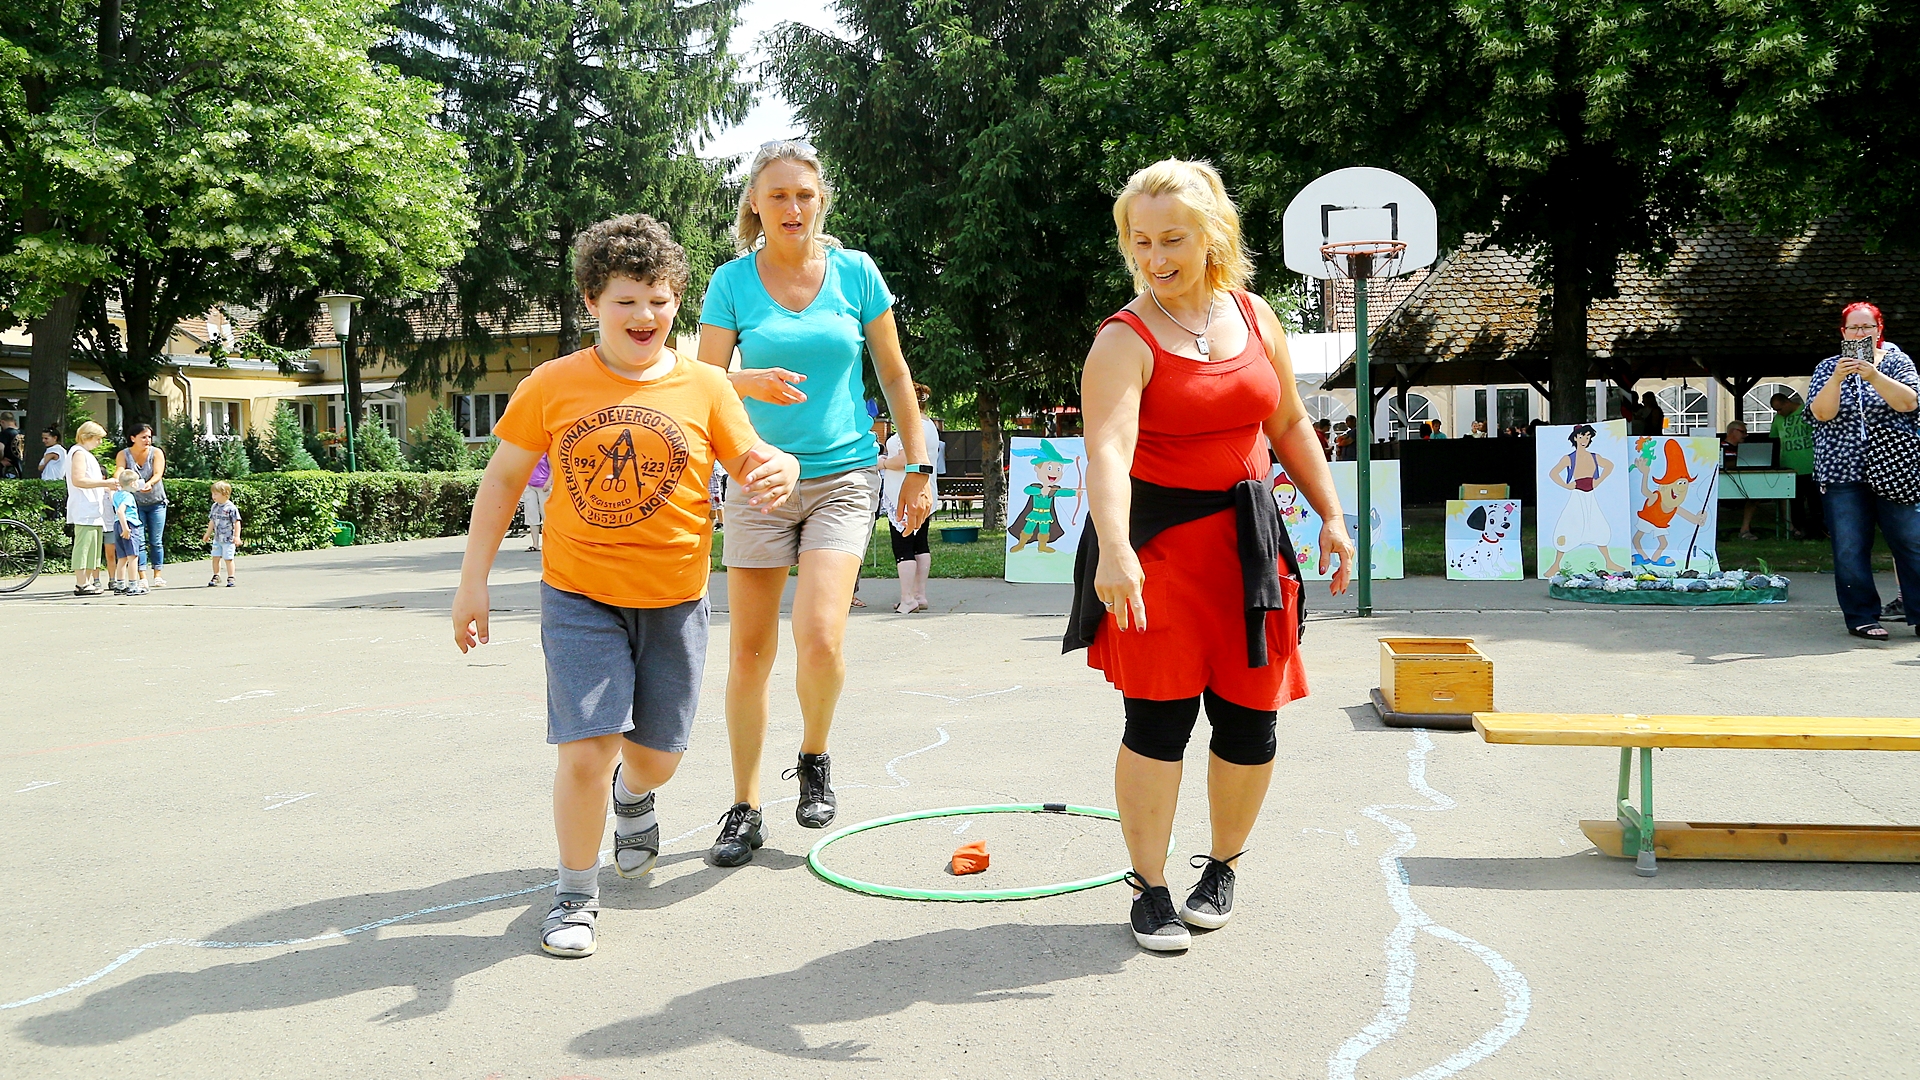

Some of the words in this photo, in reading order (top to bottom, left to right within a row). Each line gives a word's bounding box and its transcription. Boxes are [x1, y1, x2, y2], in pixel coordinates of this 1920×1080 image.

[1785, 425, 1809, 438] SAN
[574, 457, 596, 470] 894
[641, 461, 665, 473] 423
[590, 494, 632, 508] REGISTERED
[587, 510, 633, 525] 265210
